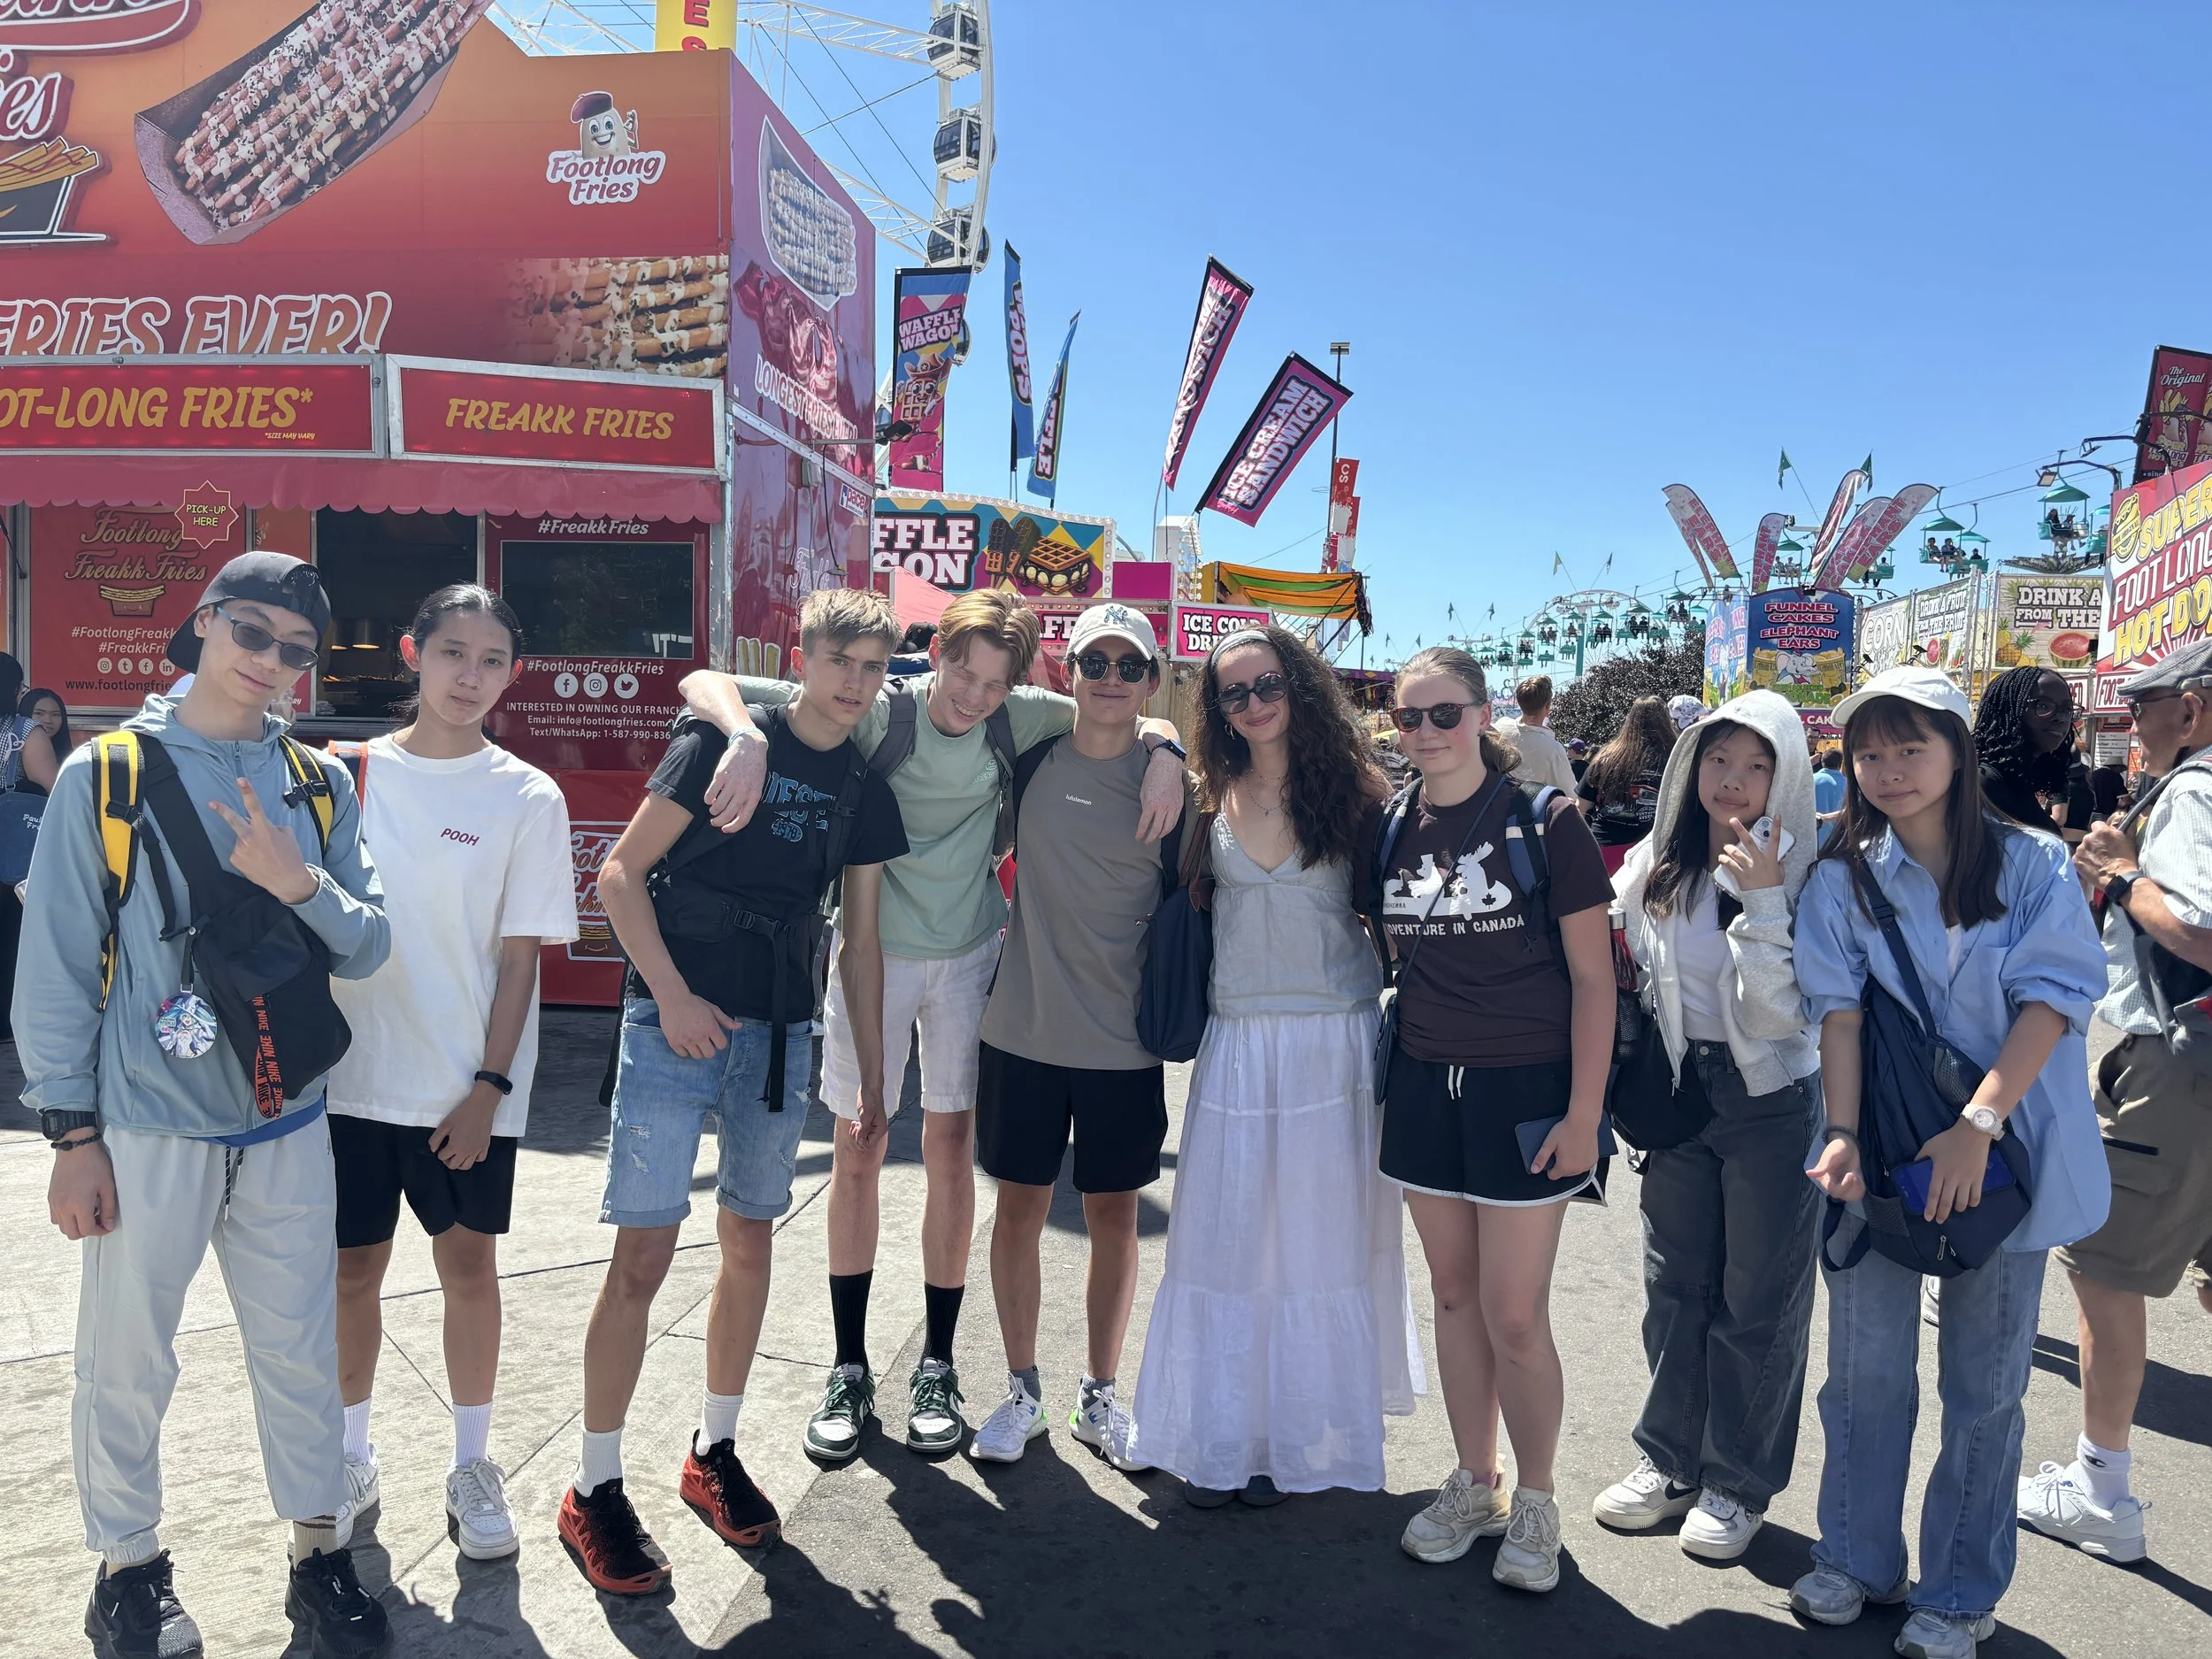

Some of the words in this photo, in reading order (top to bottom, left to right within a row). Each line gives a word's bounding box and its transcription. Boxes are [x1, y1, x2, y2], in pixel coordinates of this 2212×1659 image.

[0, 62, 62, 140] es
[550, 154, 661, 180] Footlong
[572, 177, 634, 201] Fries
[180, 292, 392, 354] EVER!
[2160, 373, 2206, 388] Original
[2169, 365, 2185, 375] The
[755, 352, 806, 420] LONGEST
[445, 397, 576, 434] FREAKK
[582, 407, 675, 440] FRIES
[1246, 379, 1310, 460] CREAM
[1236, 388, 1332, 507] SANDWICH
[186, 504, 227, 515] PICK-UP
[2136, 472, 2212, 561] SUPER
[81, 507, 183, 550] Footlong
[193, 516, 219, 526] HERE
[873, 518, 974, 550] FFLE
[65, 548, 146, 580] Freakk
[145, 550, 208, 581] Fries
[2017, 588, 2085, 606] DRINK
[2113, 559, 2162, 623] FOOT
[1764, 602, 1839, 612] FUNNEL
[2015, 607, 2053, 620] FROM
[2057, 609, 2101, 628] THE
[1182, 614, 1213, 633] ICE
[1217, 616, 1261, 634] CO
[1768, 613, 1834, 623] CAKES
[2113, 596, 2169, 670] HOT
[2171, 575, 2212, 639] DO
[1760, 626, 1839, 639] ELEPHANT
[1863, 611, 1907, 655] CORN
[1778, 638, 1821, 649] EARS
[527, 659, 664, 675] #FootlongFreakkFries
[506, 702, 563, 712] INTERESTED
[565, 703, 575, 713] IN
[578, 703, 618, 714] OWNING
[621, 704, 641, 715] OUR
[527, 715, 556, 725] Email:
[557, 717, 665, 728] info@footlongfries.com
[530, 727, 602, 740] Text/WhatsApp:
[603, 729, 671, 741] 1-587-990-836
[23, 813, 42, 823] Paul
[441, 827, 480, 847] POOH
[1453, 921, 1467, 935] IN
[1472, 914, 1525, 933] CANADA
[257, 1010, 270, 1030] NIKE
[260, 1034, 276, 1057] NIKE
[265, 1061, 282, 1083] NIKE
[273, 1087, 283, 1109] NIKE
